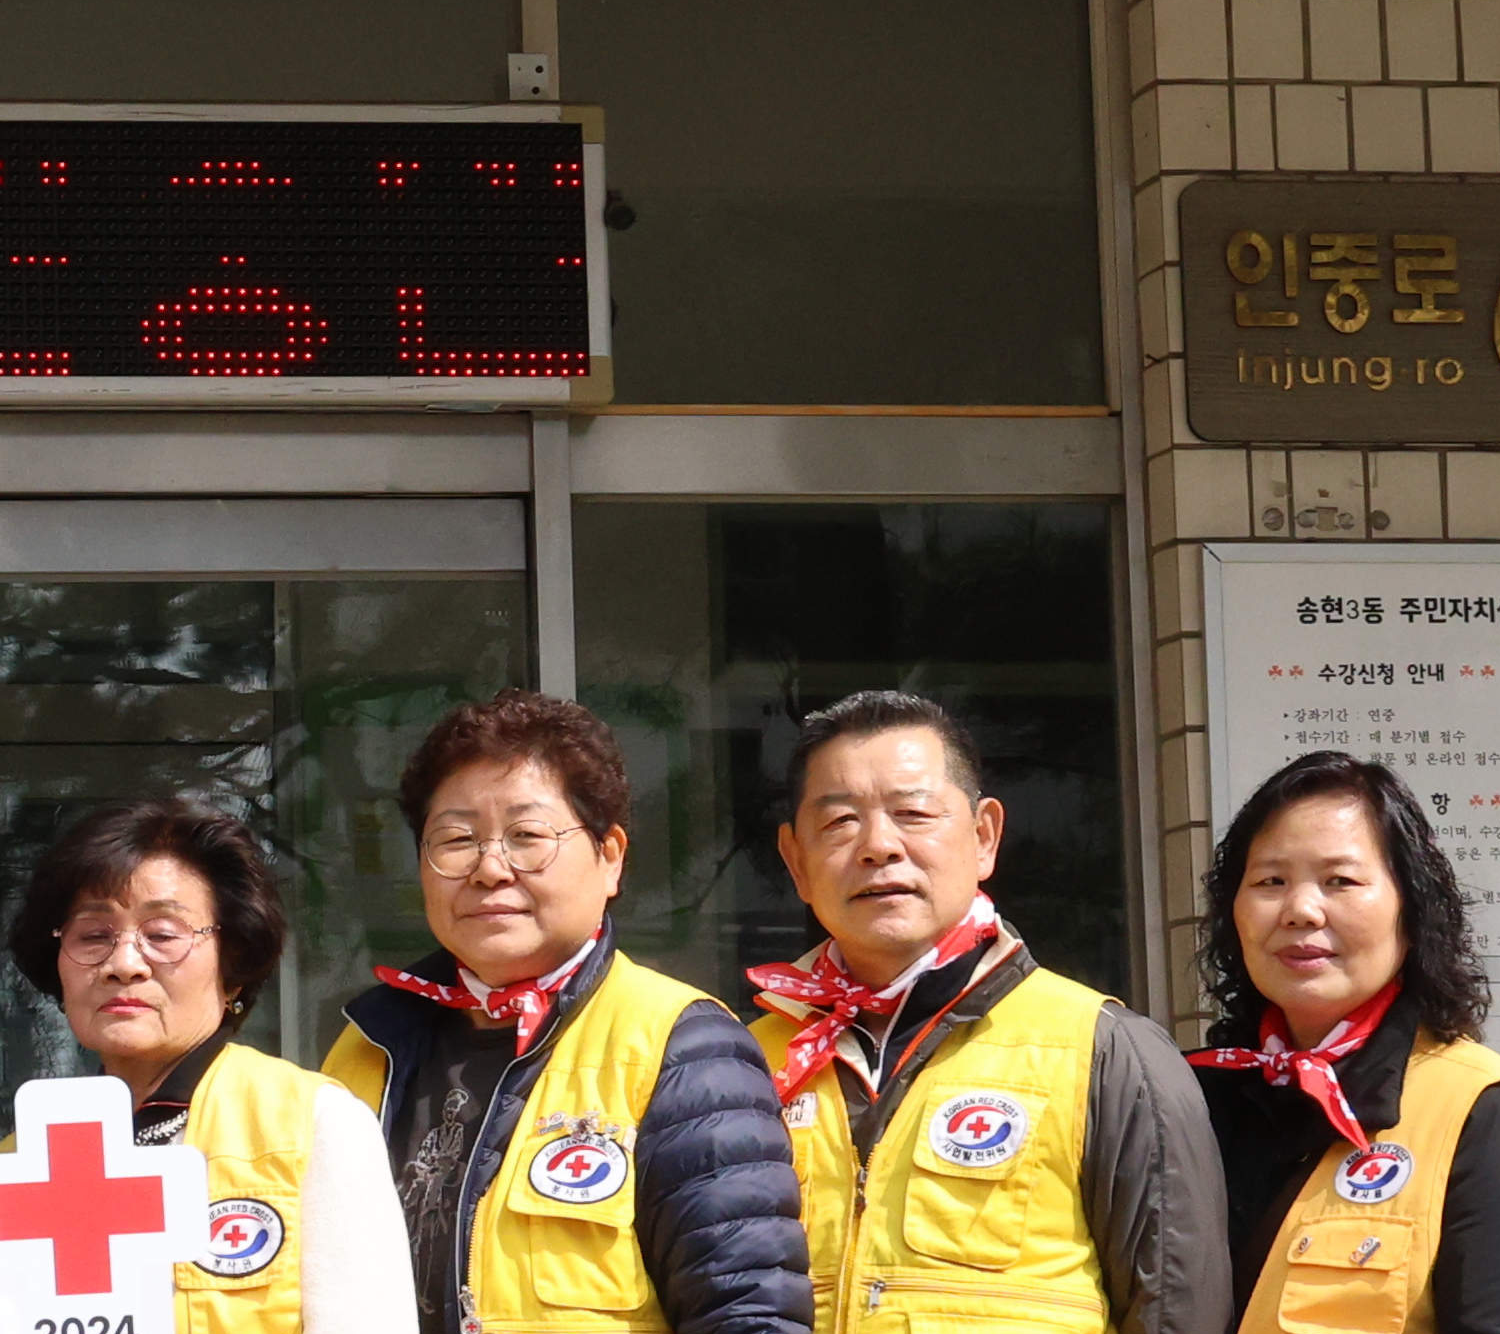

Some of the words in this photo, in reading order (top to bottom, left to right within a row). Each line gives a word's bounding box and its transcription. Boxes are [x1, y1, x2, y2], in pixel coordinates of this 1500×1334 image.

[1226, 229, 1465, 333] 인중로
[1296, 596, 1384, 625] 송현3동
[1318, 663, 1395, 685] 수강신청
[1407, 663, 1445, 684] 안내
[1294, 708, 1348, 723] 강좌기간
[1368, 708, 1395, 723] 연중
[1295, 730, 1349, 744] 접수기간
[1369, 730, 1381, 744] 매
[1440, 730, 1466, 744] 접수
[1405, 752, 1417, 766] 및
[1426, 752, 1466, 766] 온라인
[943, 1098, 975, 1119] KOREAN
[978, 1097, 994, 1105] RED
